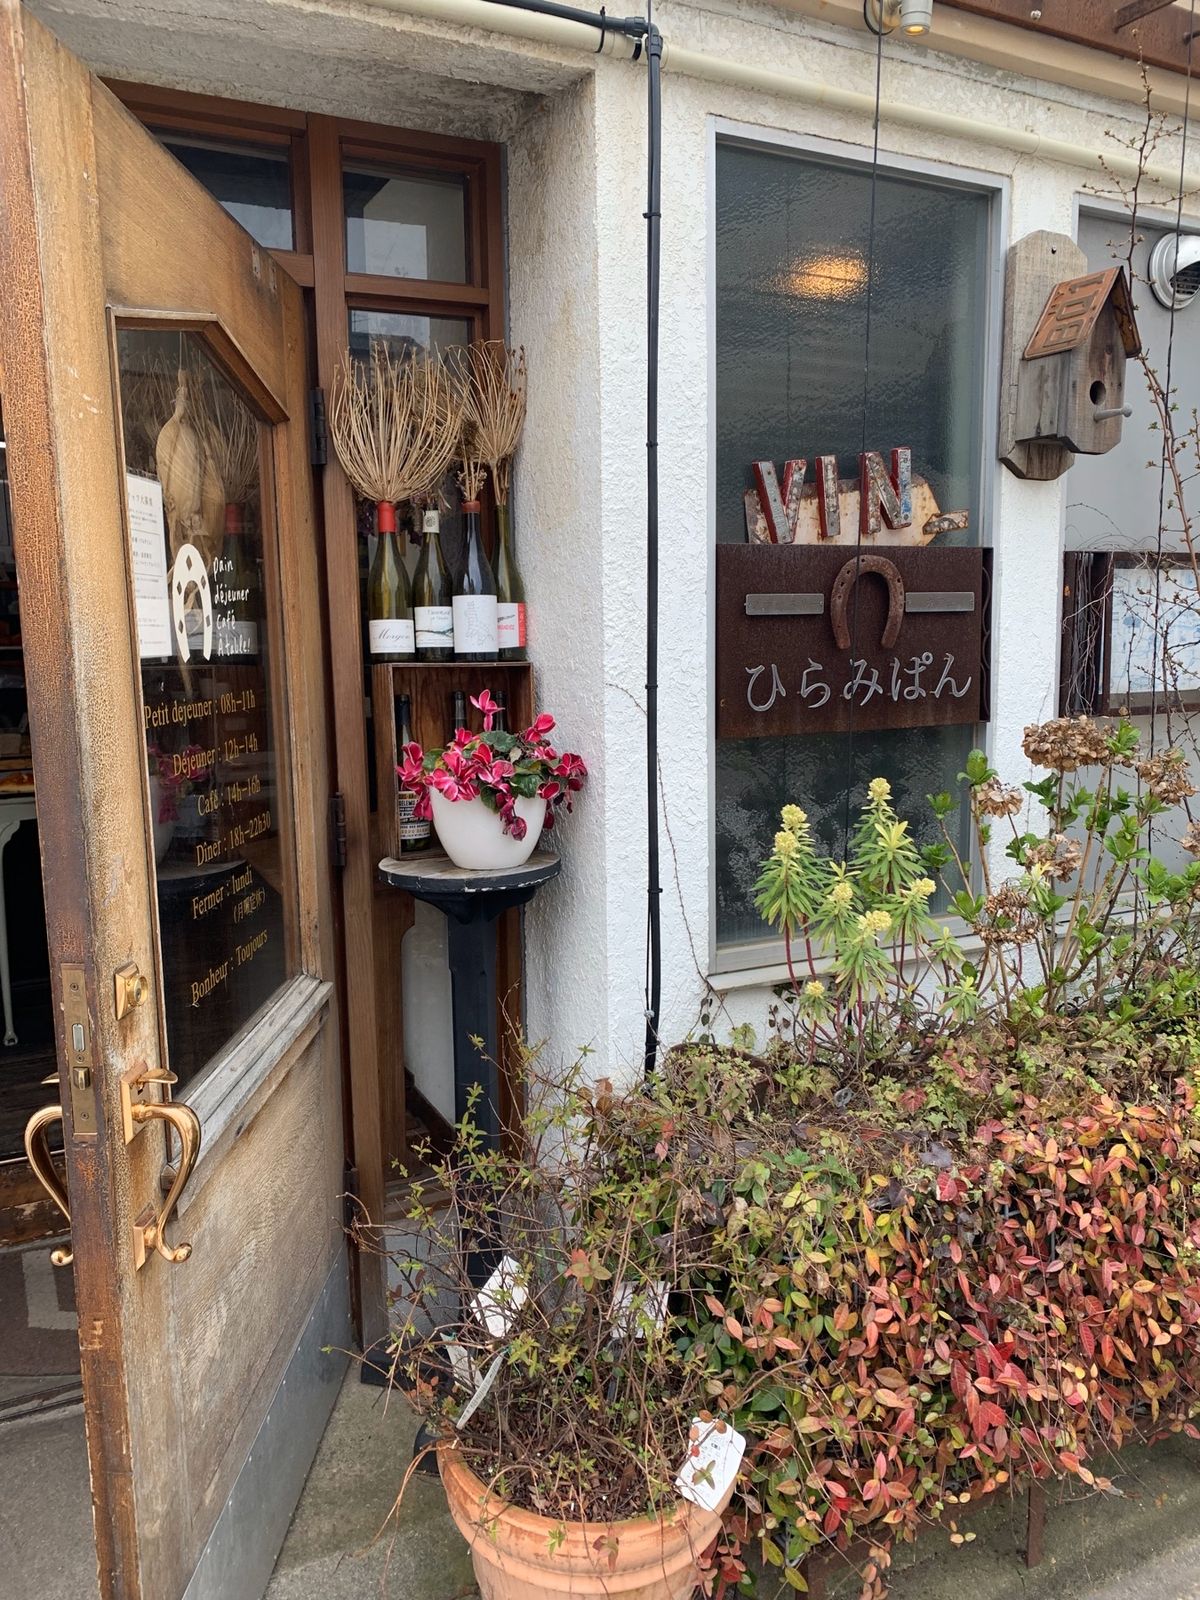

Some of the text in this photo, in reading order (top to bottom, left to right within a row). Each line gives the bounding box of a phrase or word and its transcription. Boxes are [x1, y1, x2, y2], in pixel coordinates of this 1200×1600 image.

[752, 446, 912, 544] VIN
[214, 583, 250, 606] déjeuner
[745, 651, 972, 713] ひらみぱん
[144, 702, 170, 729] Petit
[173, 747, 216, 778] Déjeuner
[197, 790, 219, 816] Café
[196, 840, 222, 868] Dîner
[192, 885, 225, 920] Fermer
[231, 864, 254, 893] lundi
[190, 962, 229, 1005] Bonheur
[235, 928, 269, 966] Toujours
